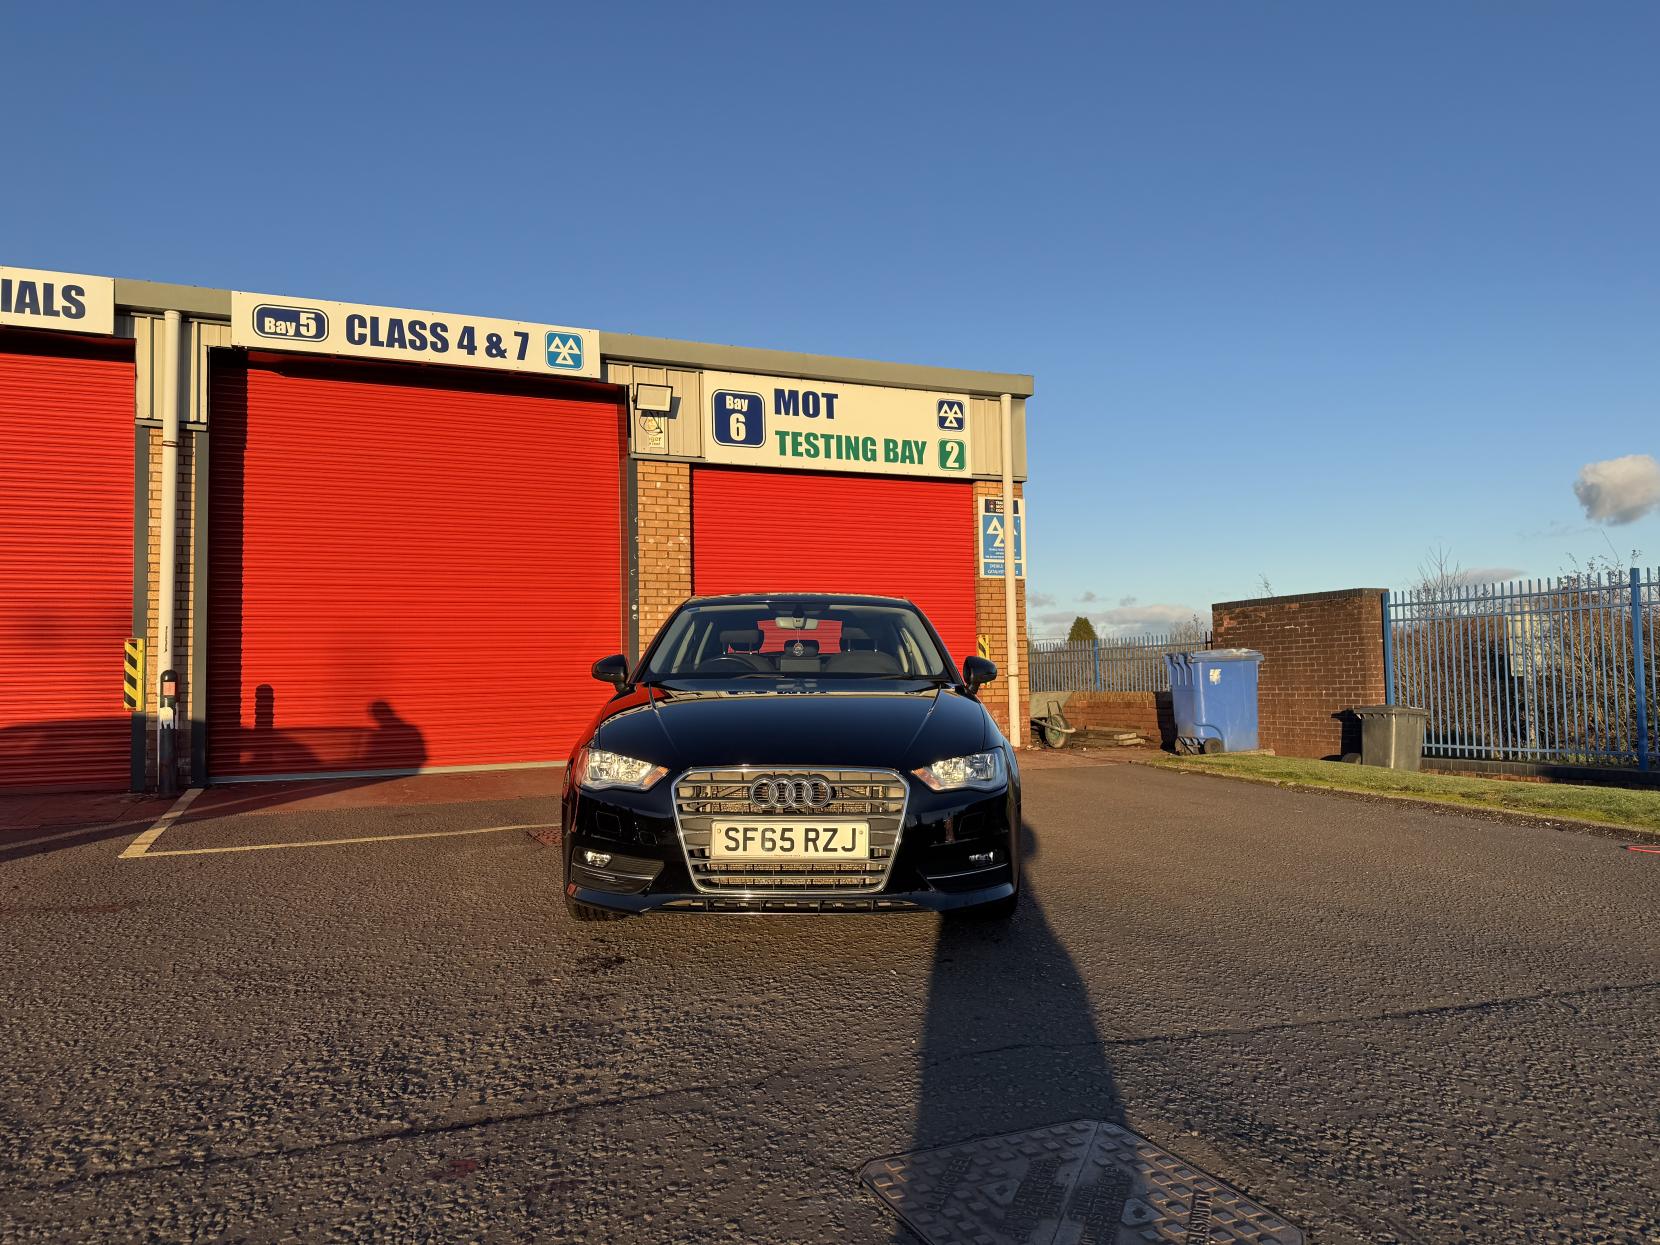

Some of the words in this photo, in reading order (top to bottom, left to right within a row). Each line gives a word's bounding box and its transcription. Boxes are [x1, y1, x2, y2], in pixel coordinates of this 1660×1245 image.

[1, 278, 86, 319] IALS
[264, 317, 296, 336] Bay
[299, 311, 317, 337] 5
[345, 313, 450, 353] CLASS
[457, 325, 478, 356] 4
[484, 332, 508, 359] &
[513, 330, 530, 361] 7
[725, 395, 749, 412] Bay
[773, 387, 839, 420] MOT
[729, 412, 746, 442] 6
[774, 429, 878, 462] TESTING
[883, 438, 928, 465] BAY
[945, 441, 961, 468] 2
[724, 827, 795, 852] SF65
[803, 827, 858, 853] RZJ
